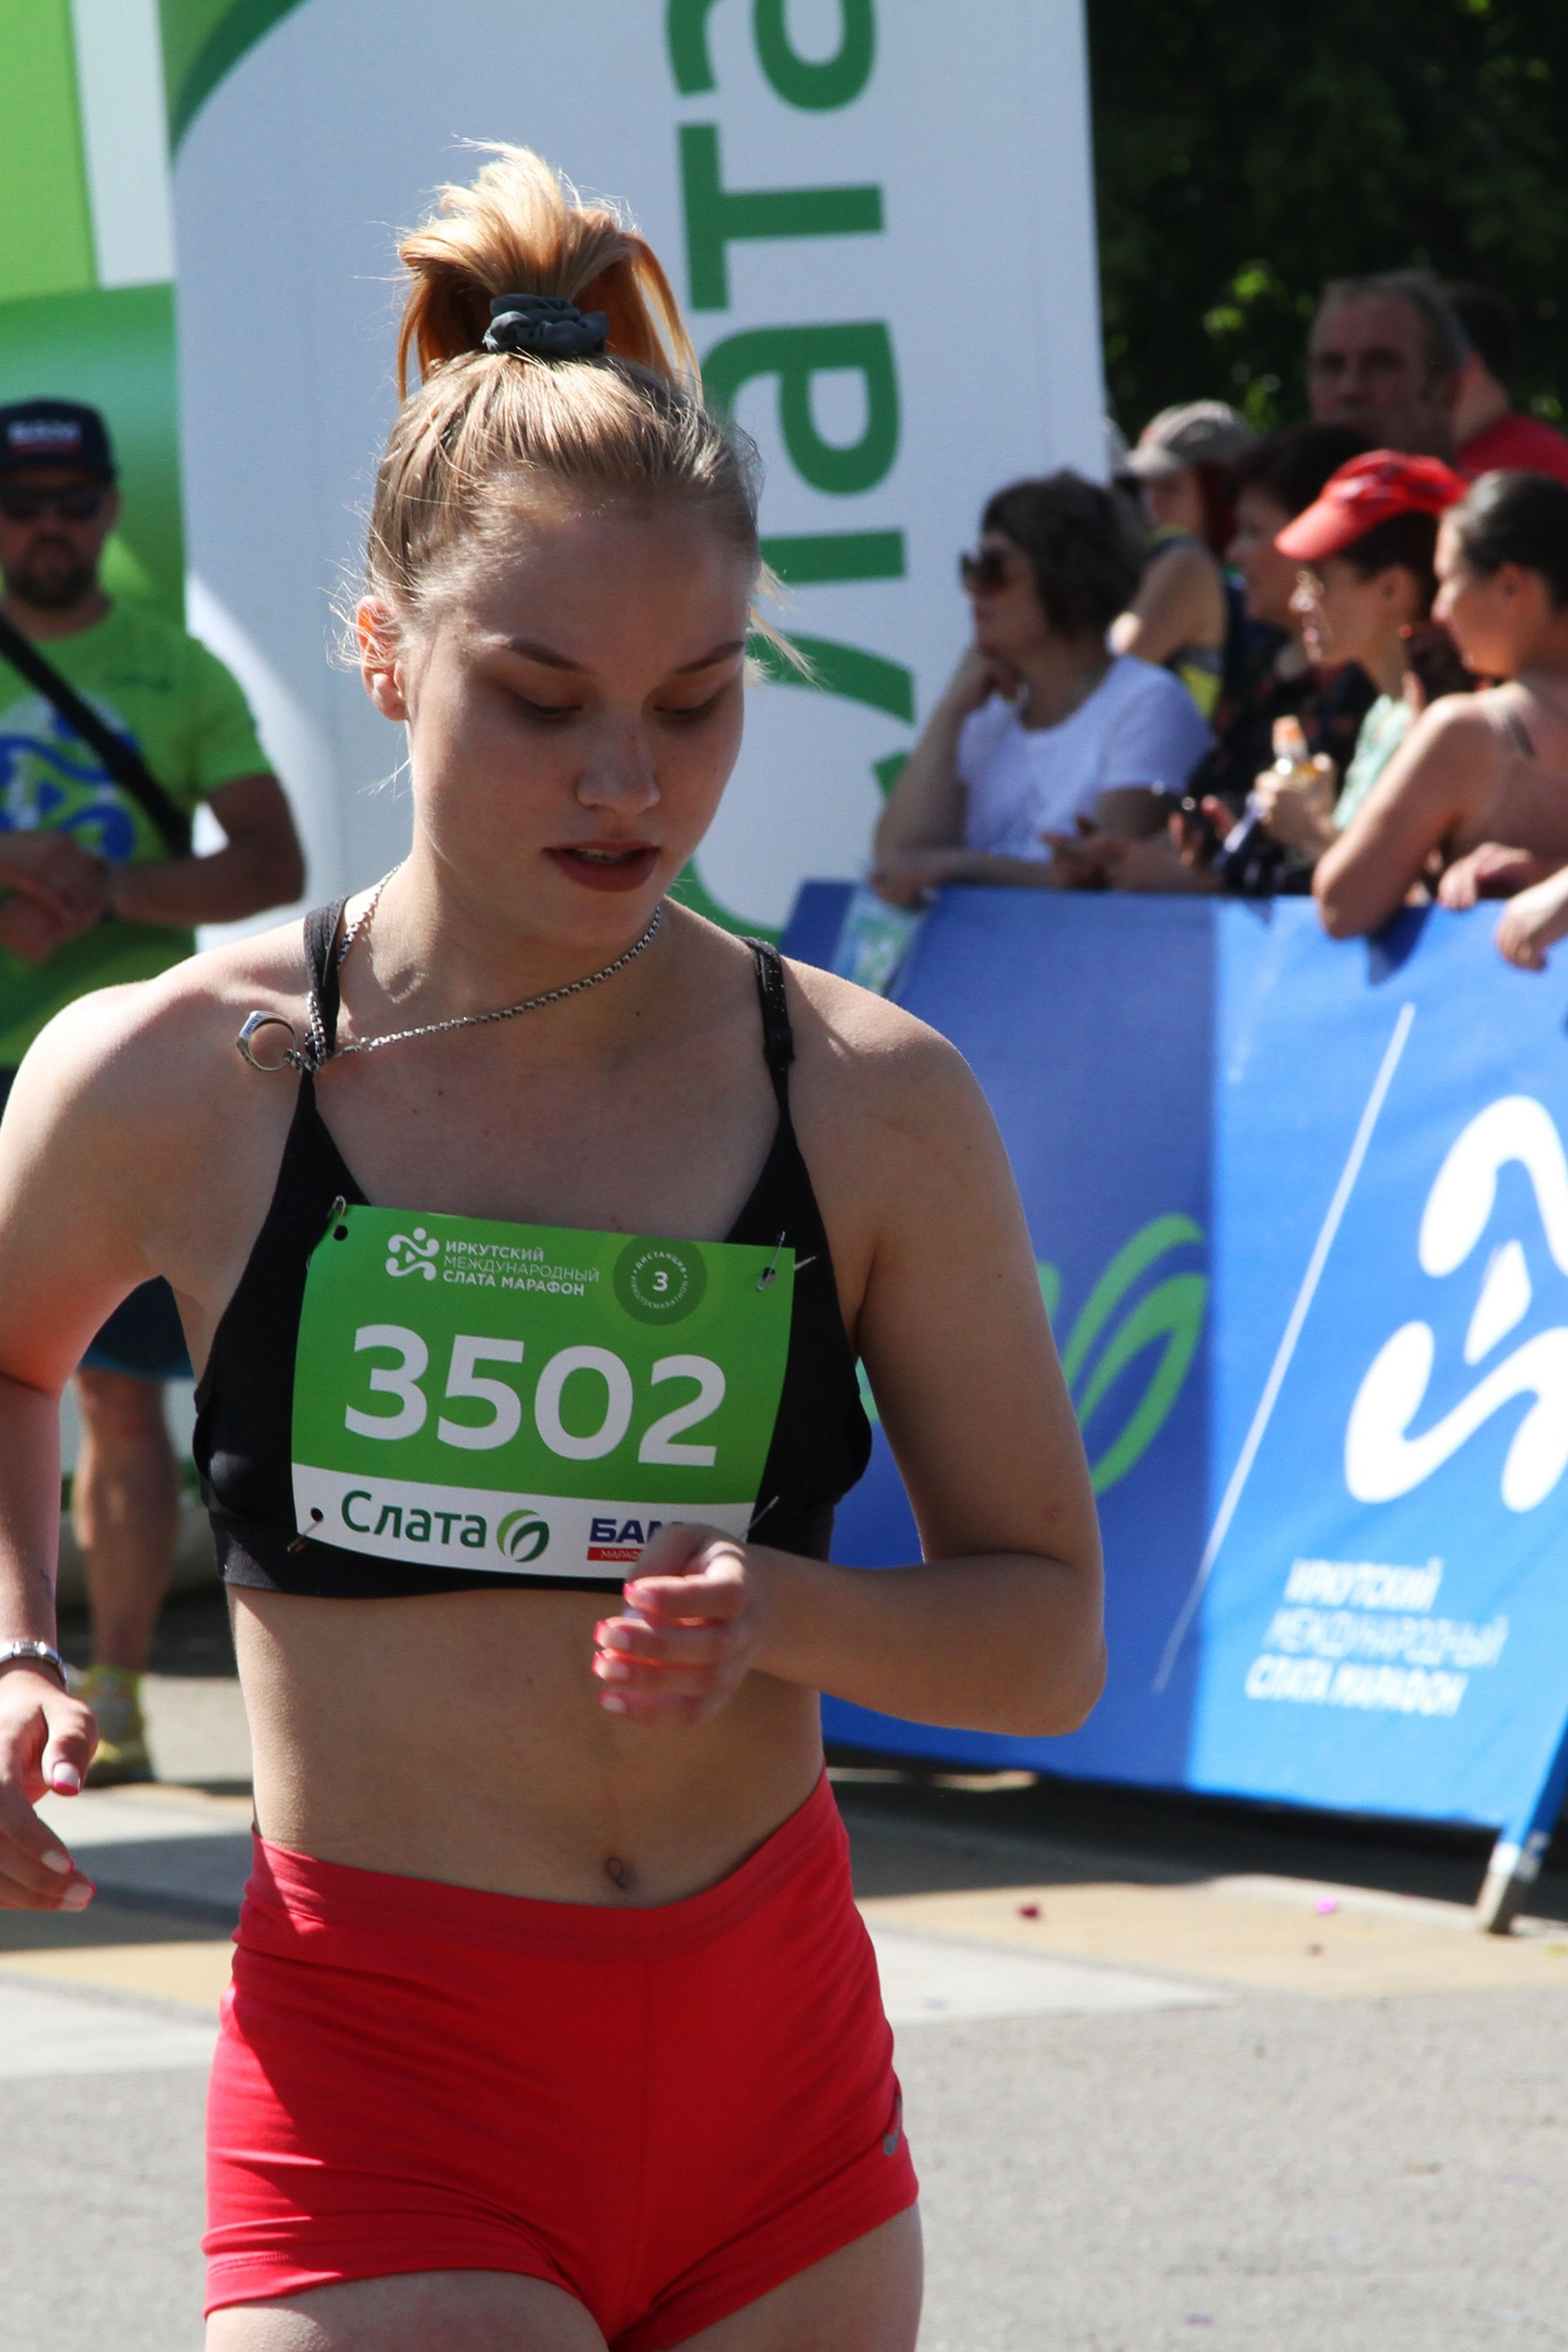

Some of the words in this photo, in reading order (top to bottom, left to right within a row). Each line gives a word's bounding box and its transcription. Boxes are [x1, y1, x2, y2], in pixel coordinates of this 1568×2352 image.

[445, 1240, 545, 1262] ИРКУТСКИЙ
[443, 1255, 600, 1283] МЕЖДУНАРОДНЫЙ
[652, 1270, 669, 1292] 3
[443, 1270, 496, 1287] СЛАТА
[501, 1276, 585, 1297] МАРАФОН
[344, 1324, 726, 1468] 3502
[341, 1489, 487, 1549] Слата
